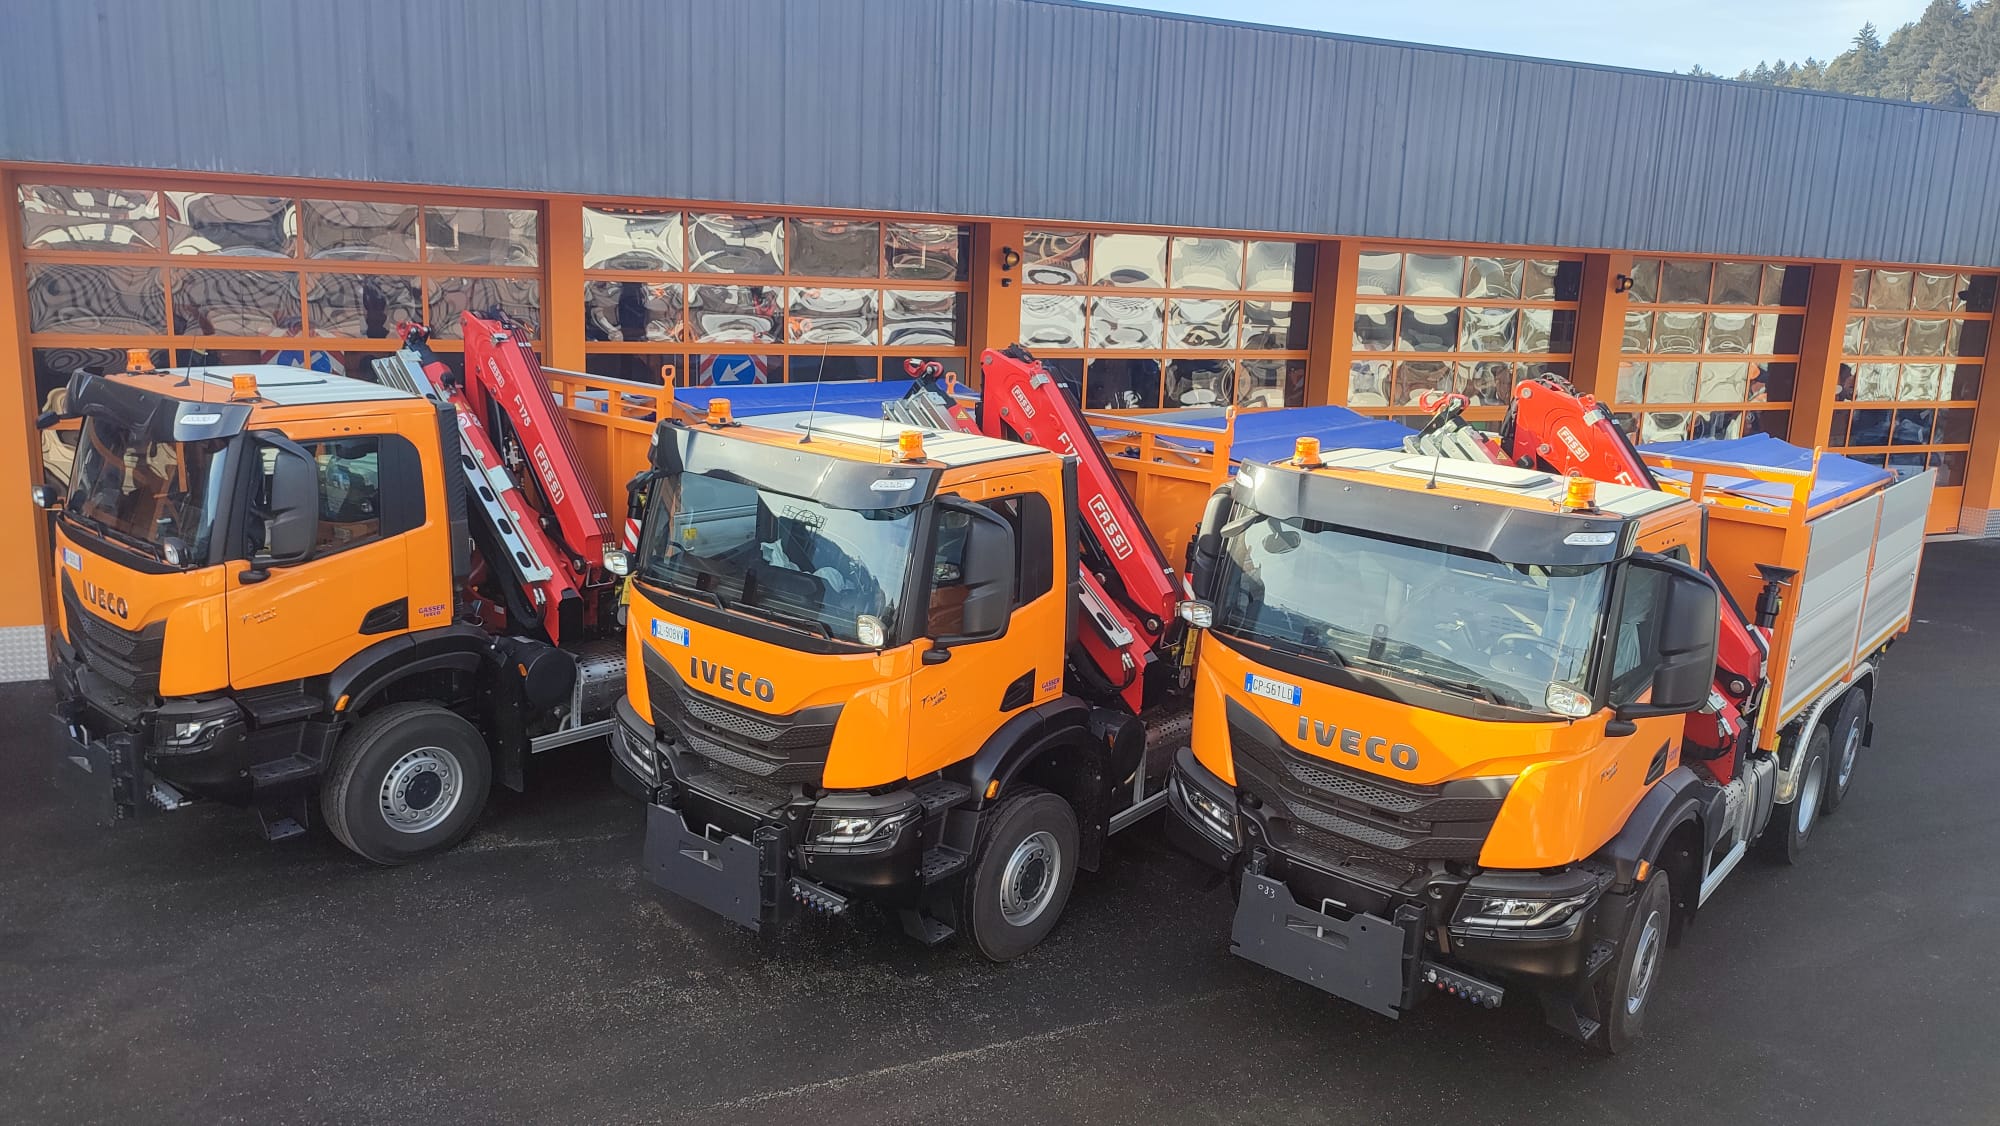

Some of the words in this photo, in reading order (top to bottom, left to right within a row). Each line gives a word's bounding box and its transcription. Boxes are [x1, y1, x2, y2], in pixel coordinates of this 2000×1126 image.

[514, 394, 531, 427] F175
[1012, 385, 1035, 417] FASSI
[1559, 428, 1588, 461] FASSI
[536, 449, 562, 499] FASSI
[1092, 500, 1129, 554] FASSI
[82, 579, 129, 620] IVECO
[690, 655, 775, 703] IVECO
[1297, 715, 1419, 771] IVECO
